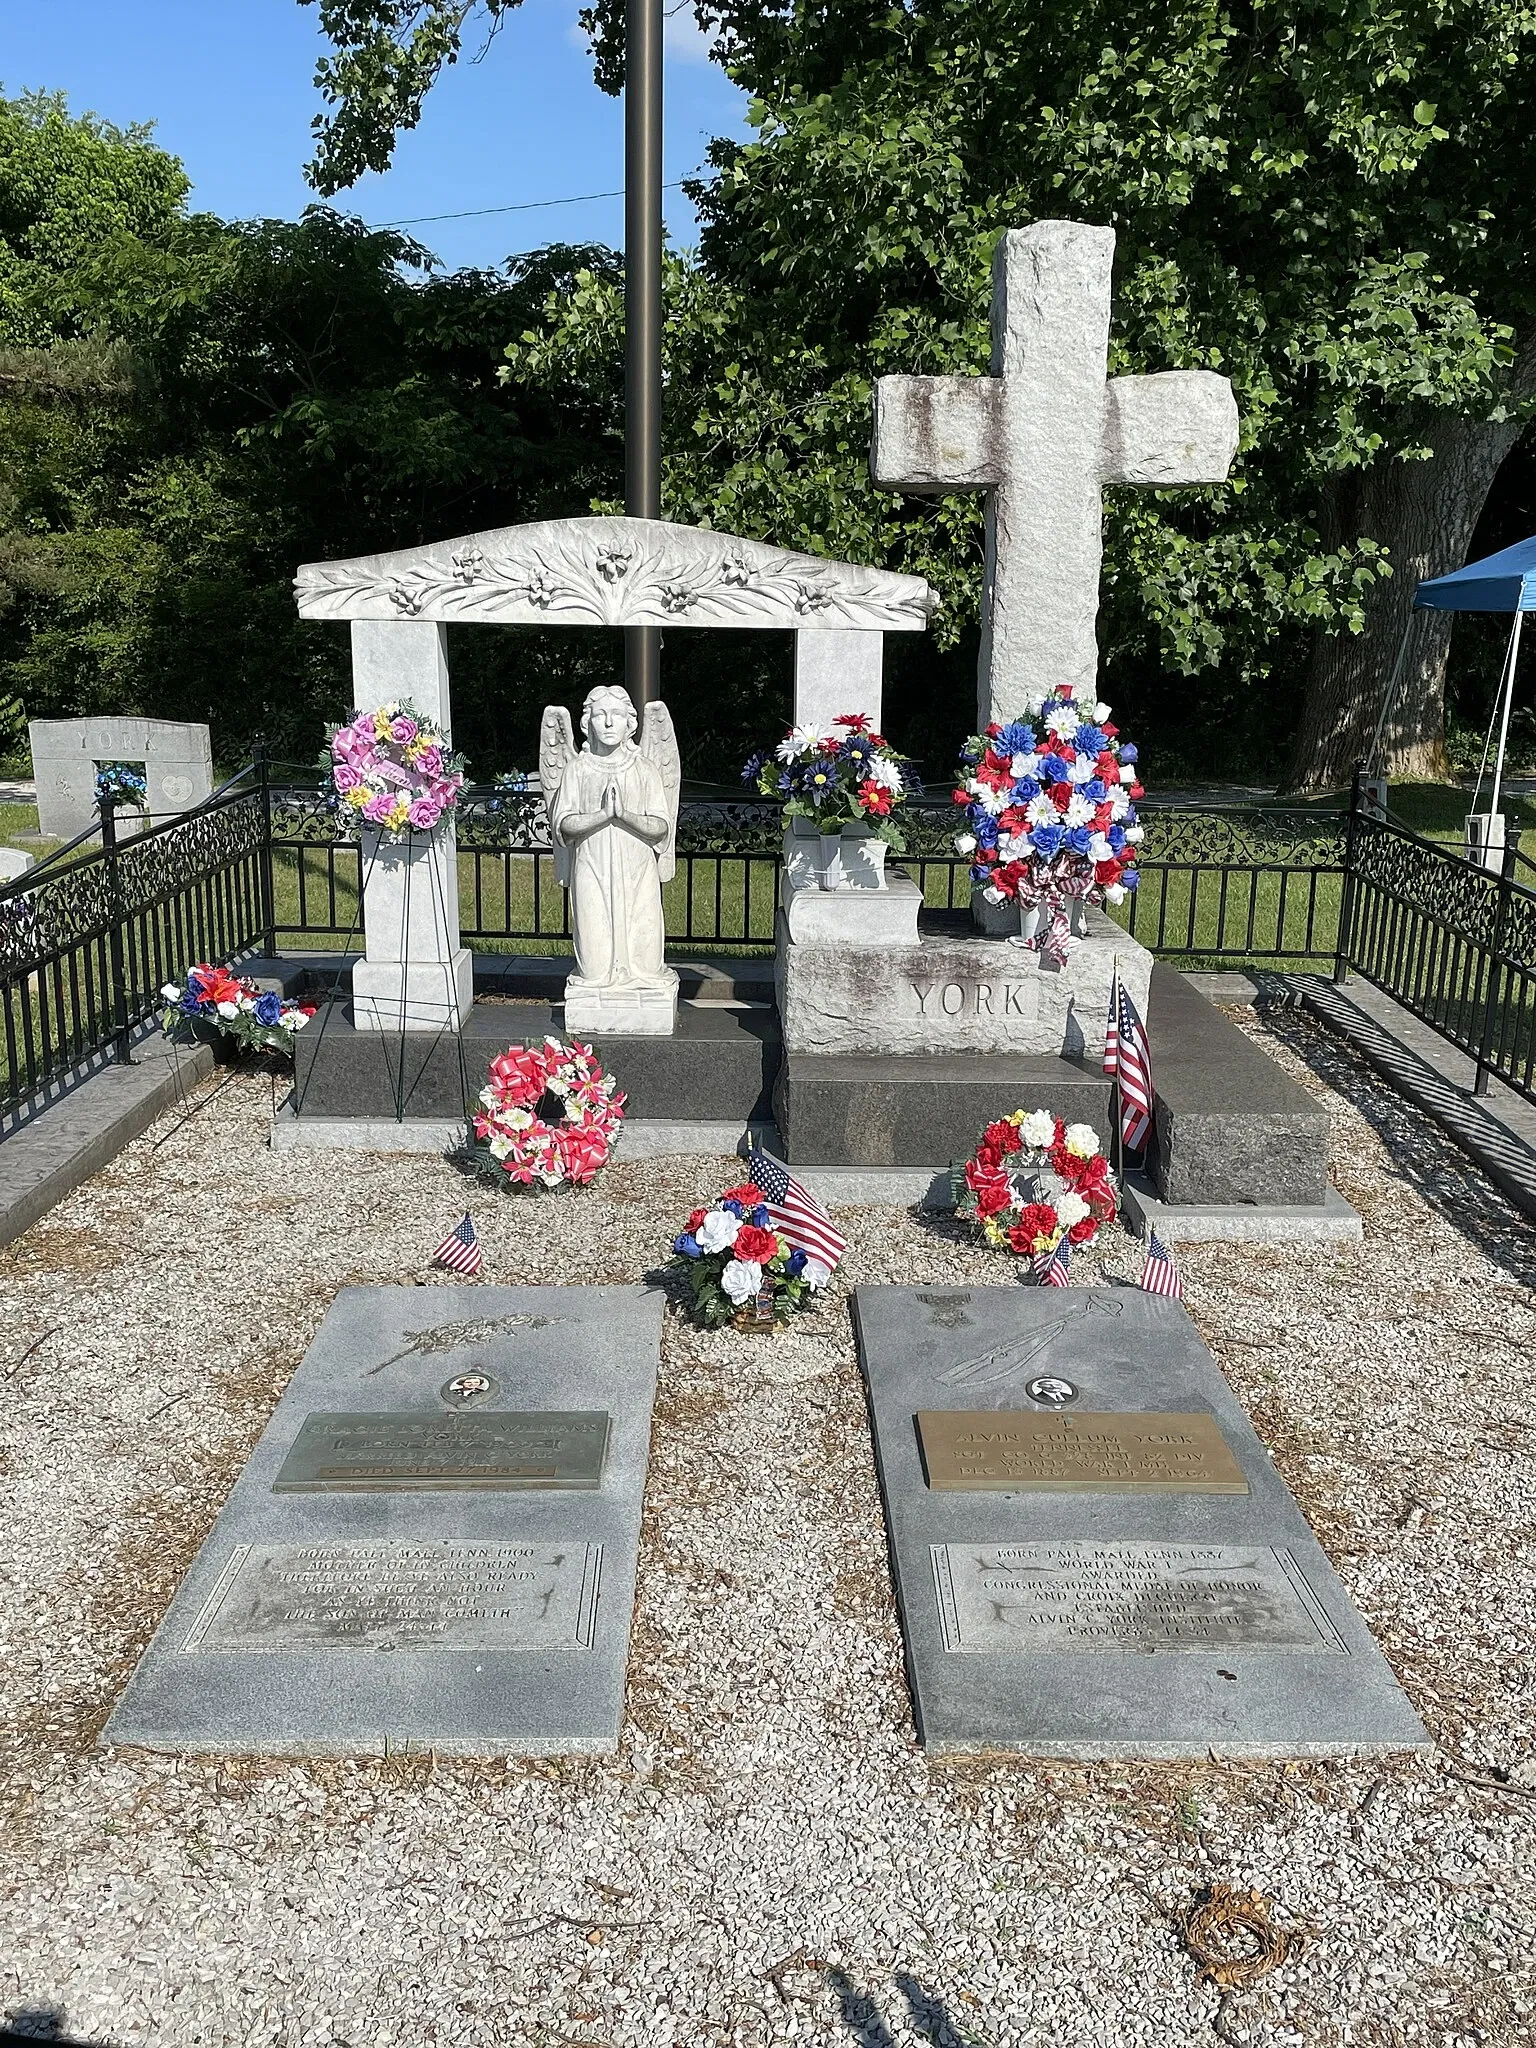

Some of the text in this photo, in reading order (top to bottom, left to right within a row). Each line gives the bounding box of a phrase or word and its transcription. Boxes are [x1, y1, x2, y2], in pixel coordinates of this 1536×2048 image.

[77, 731, 158, 751] YORK
[910, 982, 1025, 1015] YORK
[955, 1433, 1198, 1445] ALVIN CULLUM YORK
[360, 1440, 411, 1449] BORN
[1031, 1444, 1128, 1453] TENNESSEE
[952, 1451, 984, 1459] SGT
[1001, 1451, 1030, 1459] CO
[1174, 1453, 1204, 1461] DIV
[1000, 1459, 1065, 1468] WORLD
[1075, 1460, 1113, 1469] WAR
[352, 1467, 394, 1475] DIED
[482, 1466, 522, 1474] 1984
[959, 1467, 996, 1475] DEC
[1097, 1469, 1140, 1477] SEPT
[297, 1548, 342, 1558] BORN
[398, 1549, 438, 1558] MALL
[497, 1549, 534, 1557] 1900
[997, 1550, 1038, 1558] BORN
[1047, 1550, 1085, 1558] PALL
[1094, 1550, 1135, 1558] MALL
[308, 1560, 377, 1569] MOTHER
[387, 1560, 406, 1569] OF
[440, 1560, 518, 1569] CHILDREN
[1058, 1560, 1113, 1569] WORLD
[1122, 1560, 1156, 1569] WAR
[436, 1572, 478, 1581] ALSO
[487, 1571, 538, 1581] READY
[1081, 1571, 1157, 1579] AWARDED
[344, 1584, 365, 1593] IN
[426, 1583, 449, 1592] AN
[460, 1583, 506, 1592] HOUR
[984, 1580, 1262, 1590] CONGRESSIONAL MEDAL OF HONOR
[385, 1596, 437, 1605] THINK
[446, 1595, 481, 1605] NOT
[1034, 1592, 1067, 1600] AND
[1076, 1592, 1124, 1601] CROIX
[1075, 1603, 1186, 1613] ESTABLISHED
[323, 1609, 358, 1619] SON
[397, 1608, 435, 1618] MAN
[1028, 1614, 1076, 1624] ALVIN
[1105, 1615, 1149, 1625] YORK
[1160, 1616, 1240, 1625] INSTITUTE
